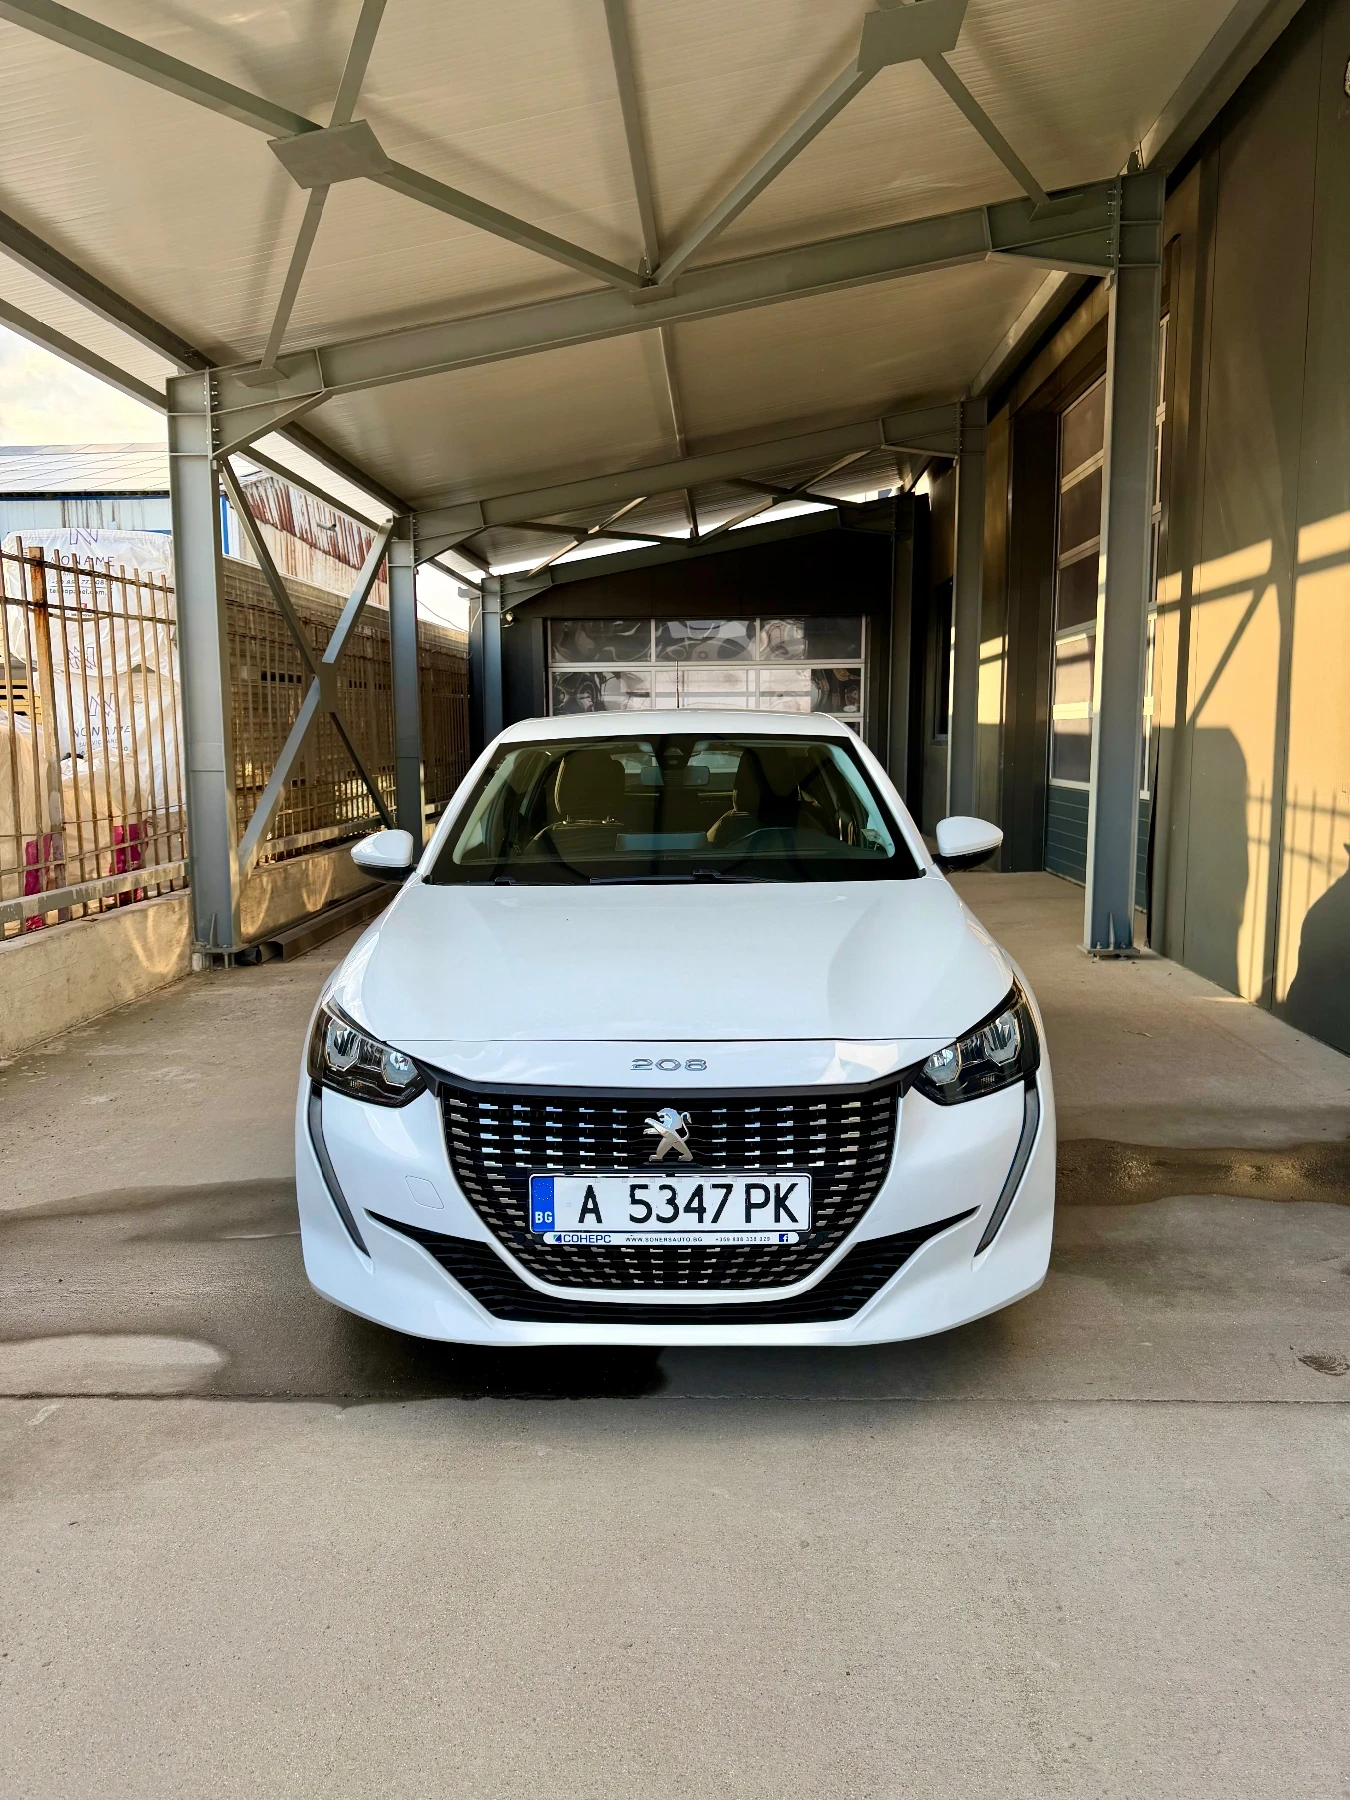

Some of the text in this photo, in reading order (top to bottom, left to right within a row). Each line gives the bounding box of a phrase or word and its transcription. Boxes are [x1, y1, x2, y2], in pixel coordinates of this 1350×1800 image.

[630, 1058, 708, 1071] 208
[578, 1183, 799, 1224] A 5347 PK
[534, 1211, 553, 1224] BG
